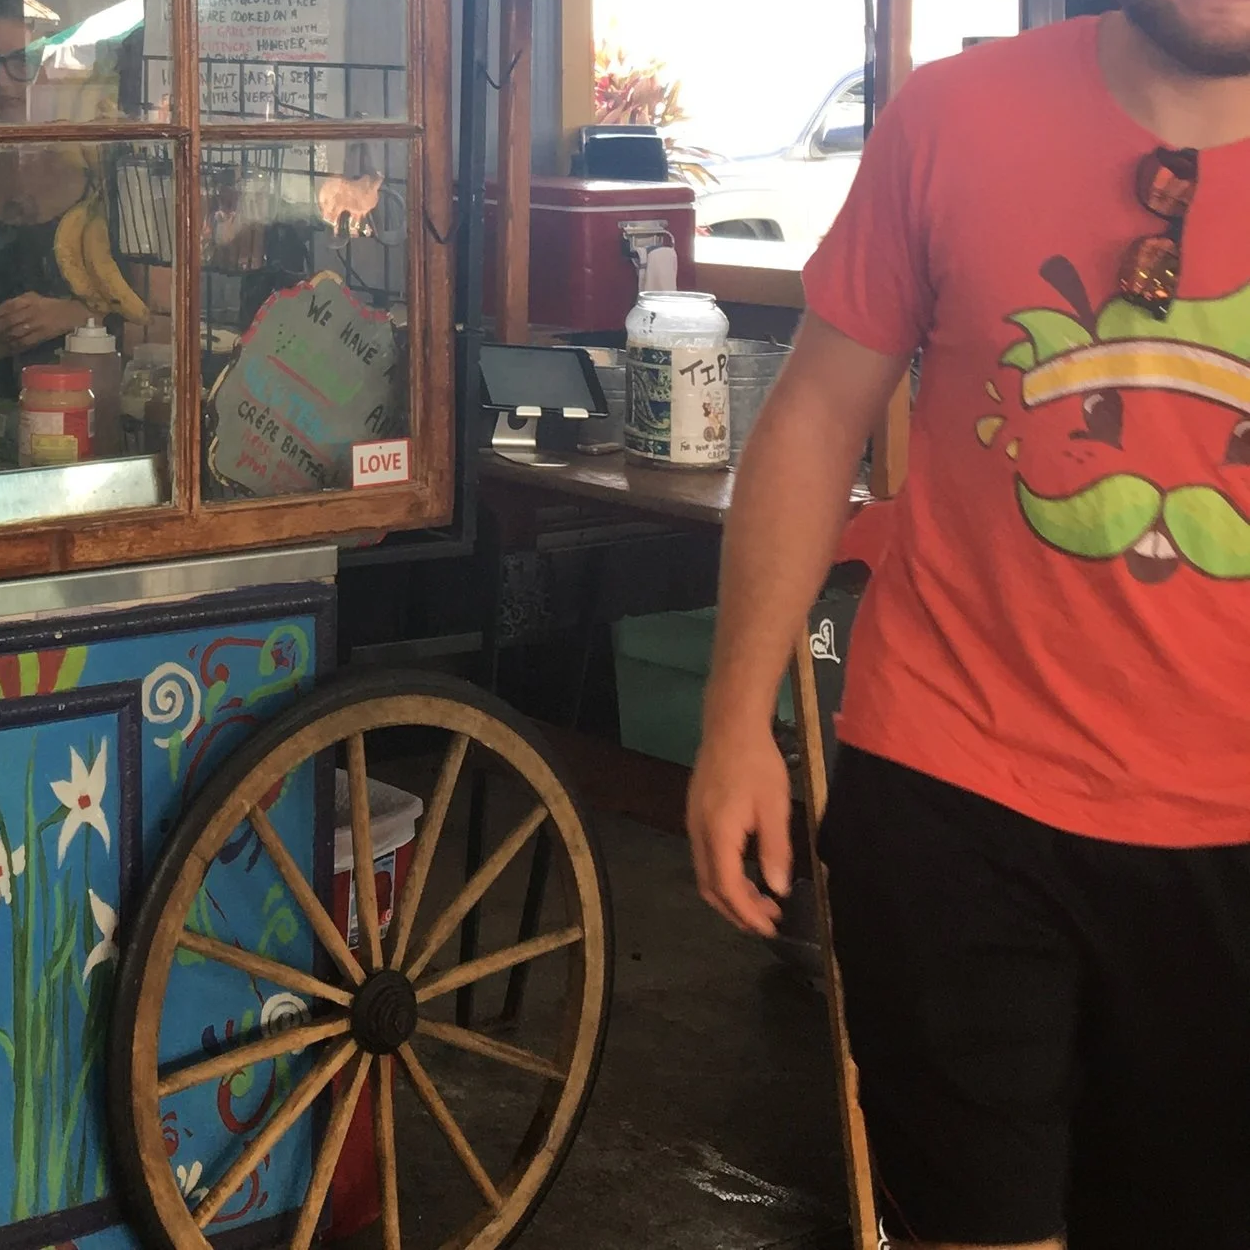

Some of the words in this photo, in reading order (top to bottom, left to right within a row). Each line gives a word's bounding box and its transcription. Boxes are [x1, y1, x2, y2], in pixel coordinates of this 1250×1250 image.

[307, 295, 332, 327] WE
[340, 321, 378, 366] HAVE
[359, 453, 402, 475] LOVE
